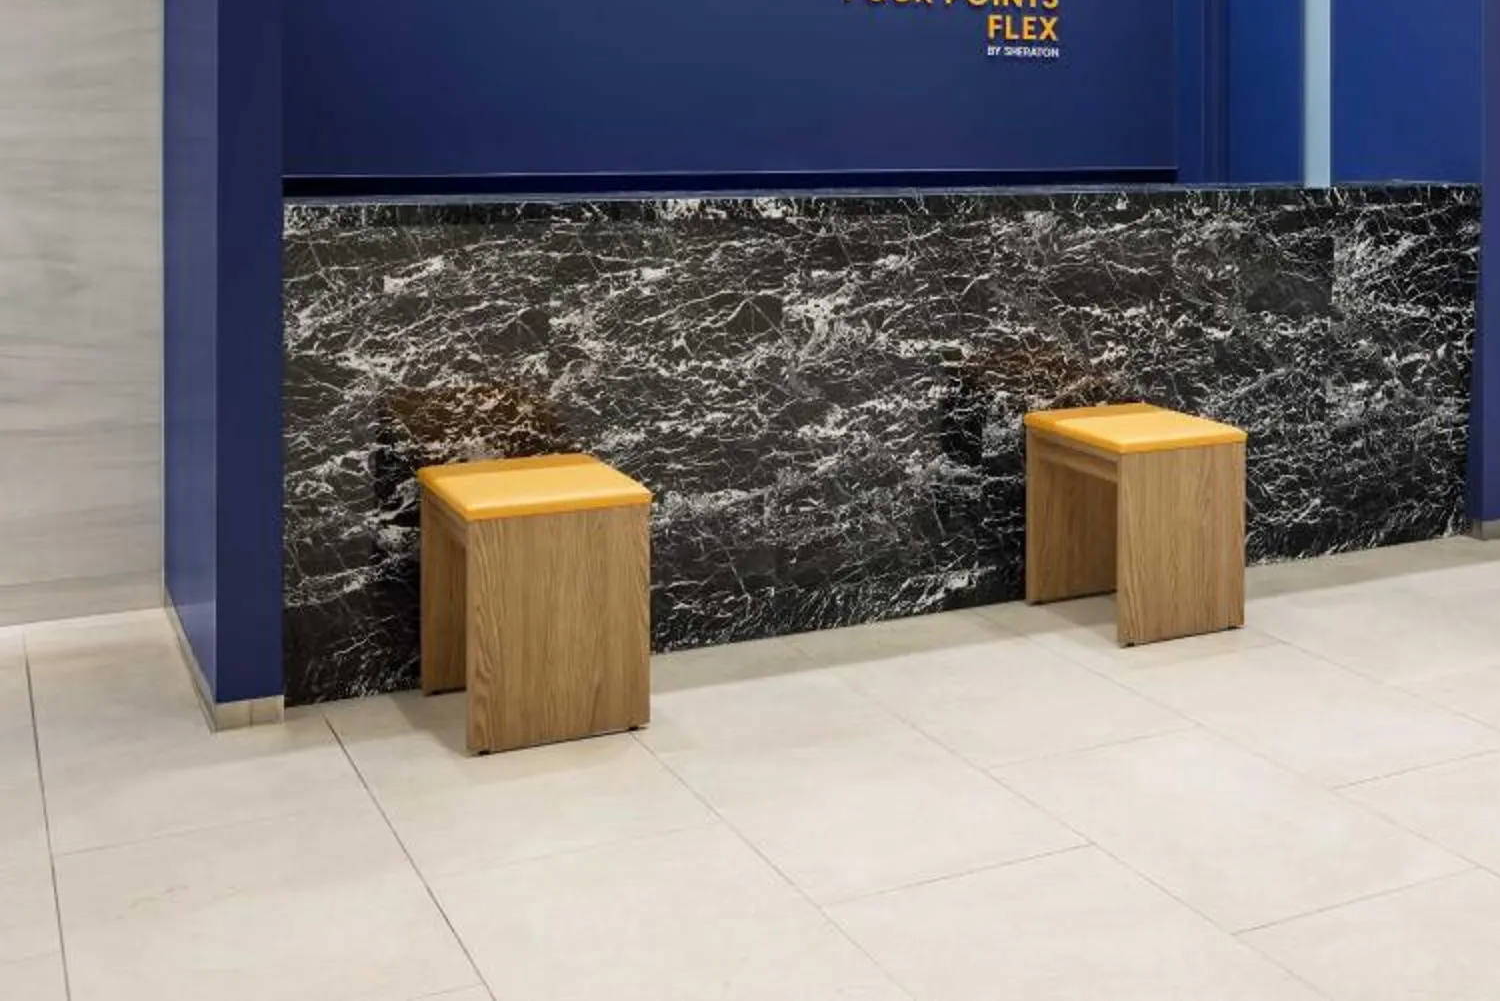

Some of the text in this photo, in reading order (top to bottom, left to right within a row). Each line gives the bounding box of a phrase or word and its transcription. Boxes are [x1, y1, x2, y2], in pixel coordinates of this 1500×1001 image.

[987, 14, 1058, 41] FLEX
[987, 46, 1060, 58] BY SHERATON
